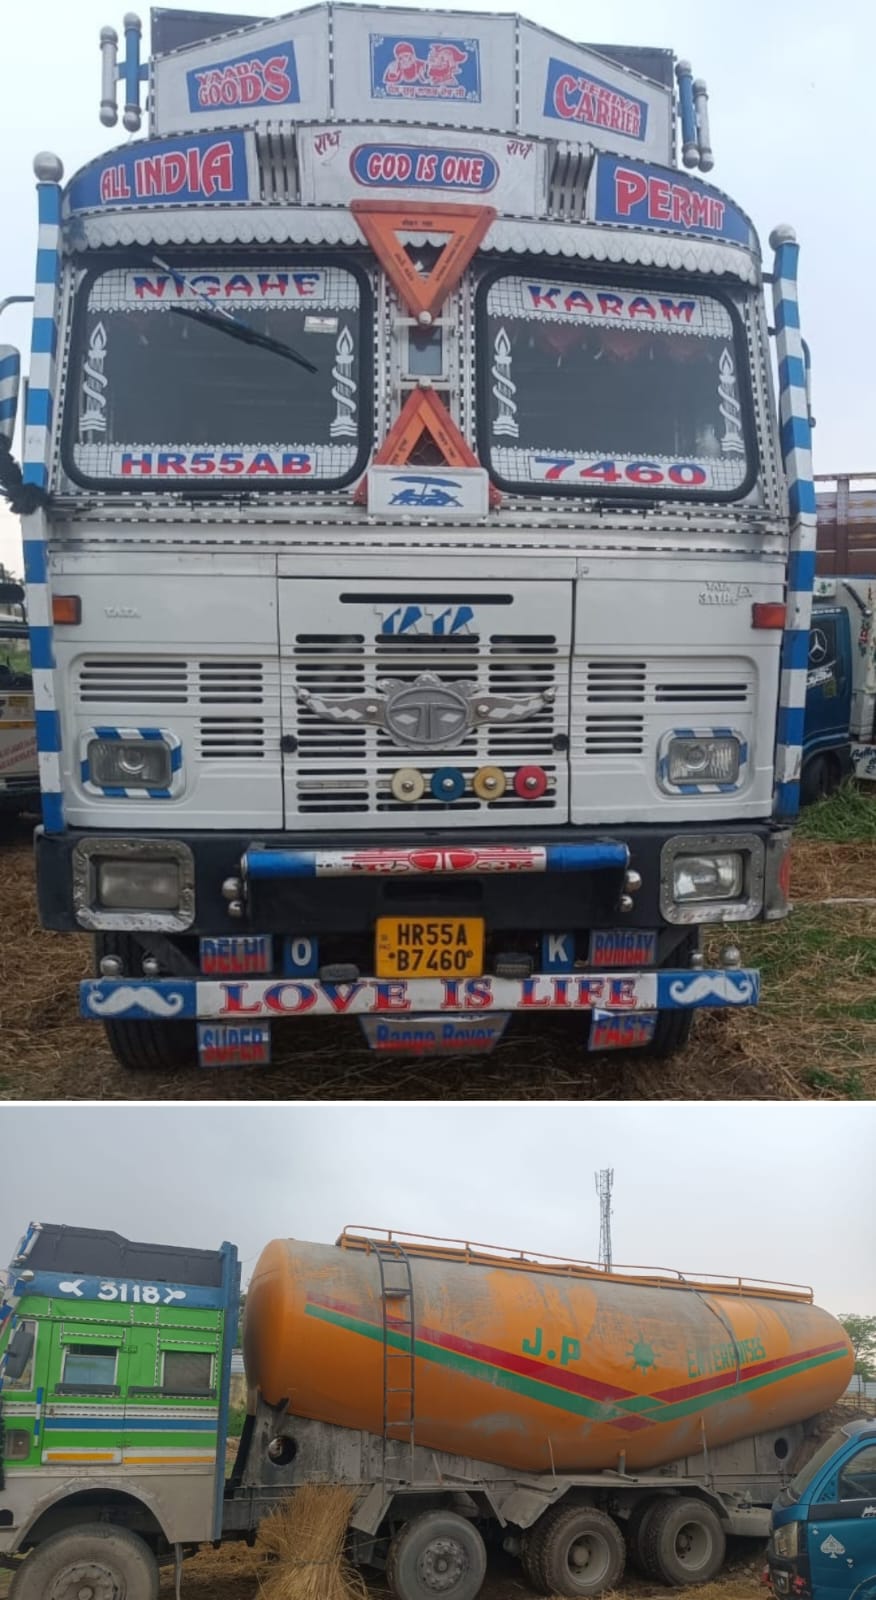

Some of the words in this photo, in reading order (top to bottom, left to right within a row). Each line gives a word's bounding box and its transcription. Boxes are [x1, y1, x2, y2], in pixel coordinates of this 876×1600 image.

[197, 55, 291, 106] GOODS
[553, 73, 640, 137] CARRIER
[100, 163, 131, 203] ALL
[134, 141, 233, 198] INDIA
[367, 152, 412, 181] GOD
[415, 153, 438, 182] IS
[441, 156, 484, 185] ONE
[614, 166, 726, 231] PERMIT
[132, 273, 321, 299] NIGAHE
[527, 285, 696, 324] KARAM
[121, 452, 313, 475] HR55AB
[534, 456, 707, 485] 7460
[396, 922, 467, 947] HR55A
[548, 933, 568, 962] K
[203, 938, 266, 974] DELHI
[396, 948, 467, 972] B7460
[219, 982, 411, 1016] LOVE
[440, 977, 494, 1009] IS
[517, 976, 637, 1009] LIFE
[97, 1279, 161, 1304] 3118
[522, 1327, 582, 1367] J.P
